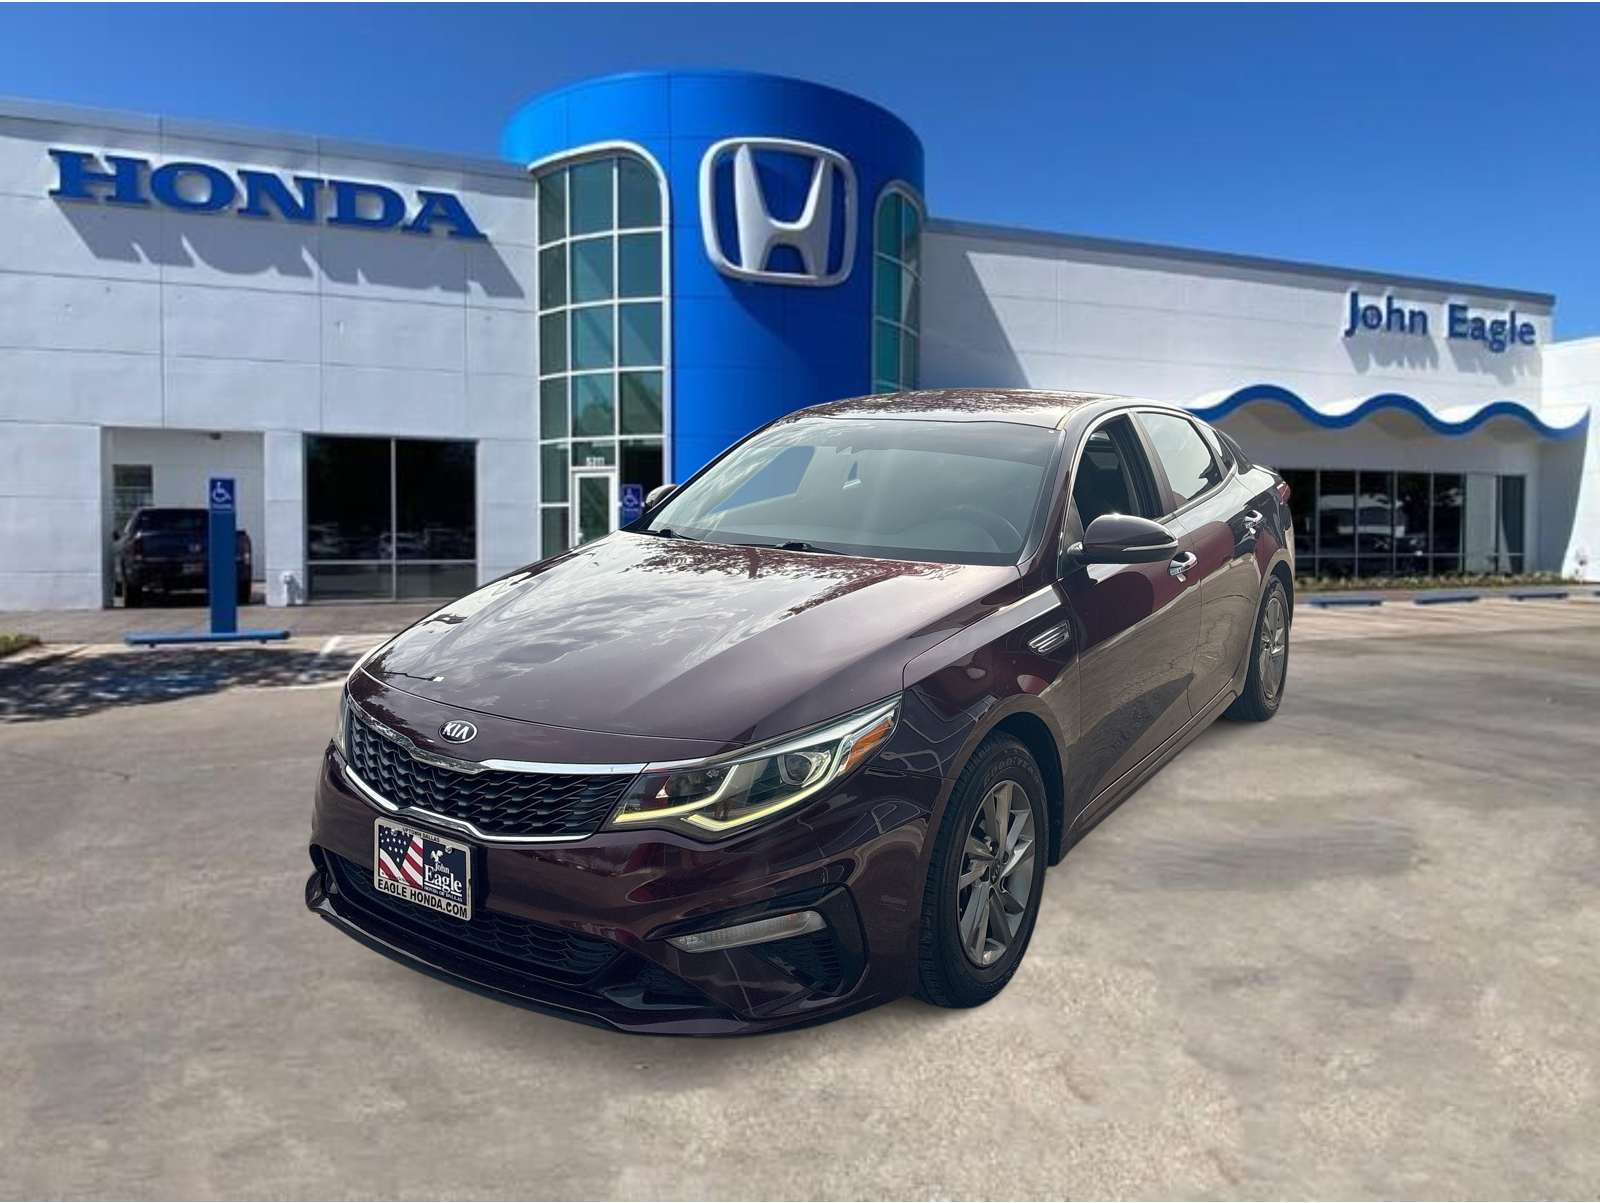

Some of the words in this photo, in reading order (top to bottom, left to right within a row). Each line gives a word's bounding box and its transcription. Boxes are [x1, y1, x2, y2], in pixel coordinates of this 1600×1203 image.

[48, 148, 487, 240] HONDA
[1344, 290, 1428, 338] John
[1448, 303, 1536, 353] Eagle
[442, 722, 470, 740] KIA
[424, 864, 462, 893] Eagle
[434, 862, 450, 874] John
[378, 879, 408, 898] EAGLE
[410, 890, 468, 919] HONDA.COM
